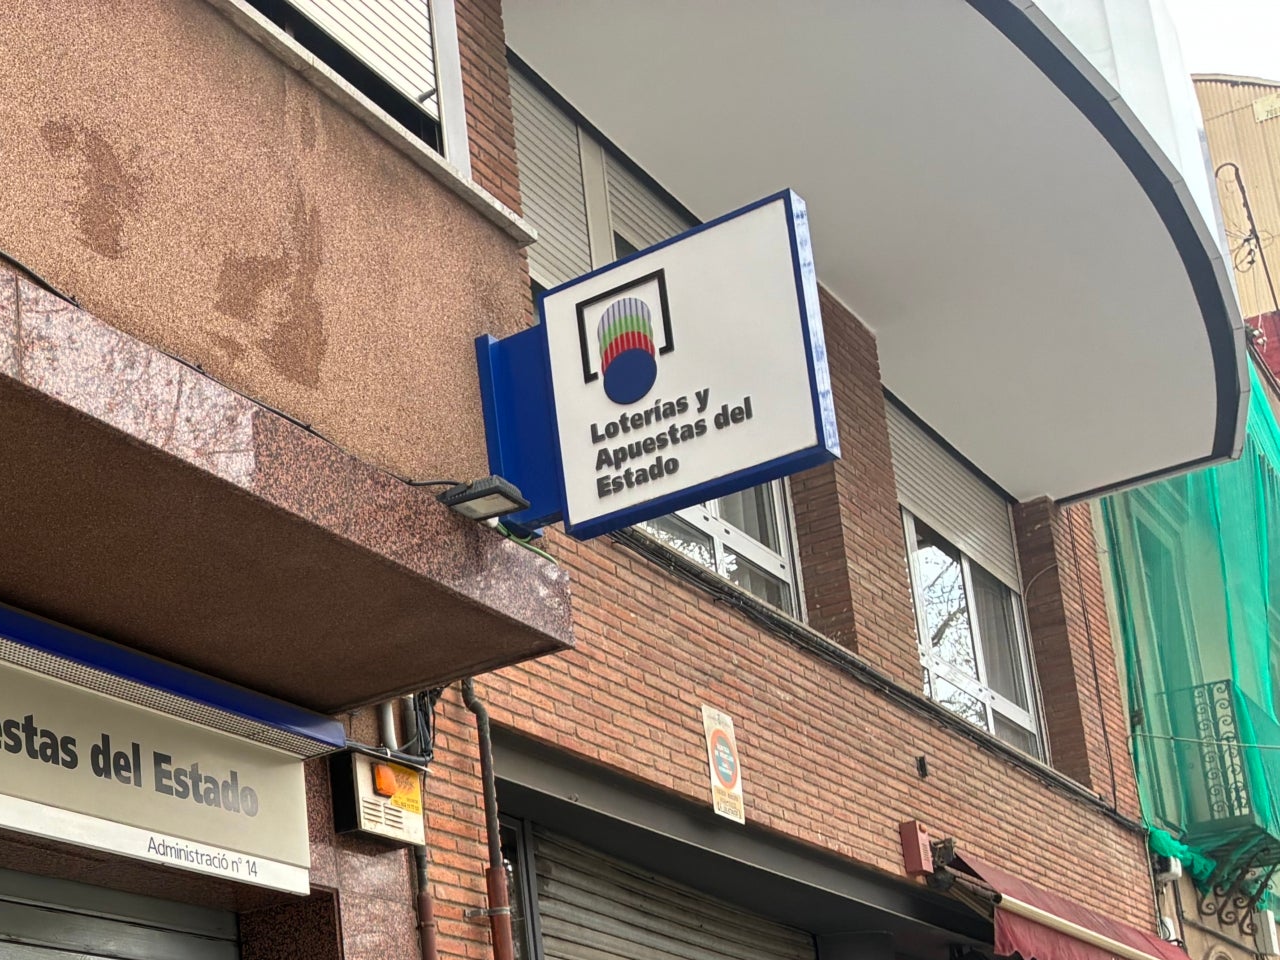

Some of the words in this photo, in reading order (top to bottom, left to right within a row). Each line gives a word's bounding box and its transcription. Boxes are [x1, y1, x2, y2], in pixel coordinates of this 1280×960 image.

[590, 397, 689, 445] Loterías
[694, 387, 710, 414] y
[595, 418, 708, 471] Apuestas
[713, 396, 753, 430] del
[596, 456, 680, 498] Estado
[90, 733, 143, 788] del
[153, 751, 260, 818] Estado
[147, 836, 229, 871] Administració
[245, 860, 258, 877] 14
